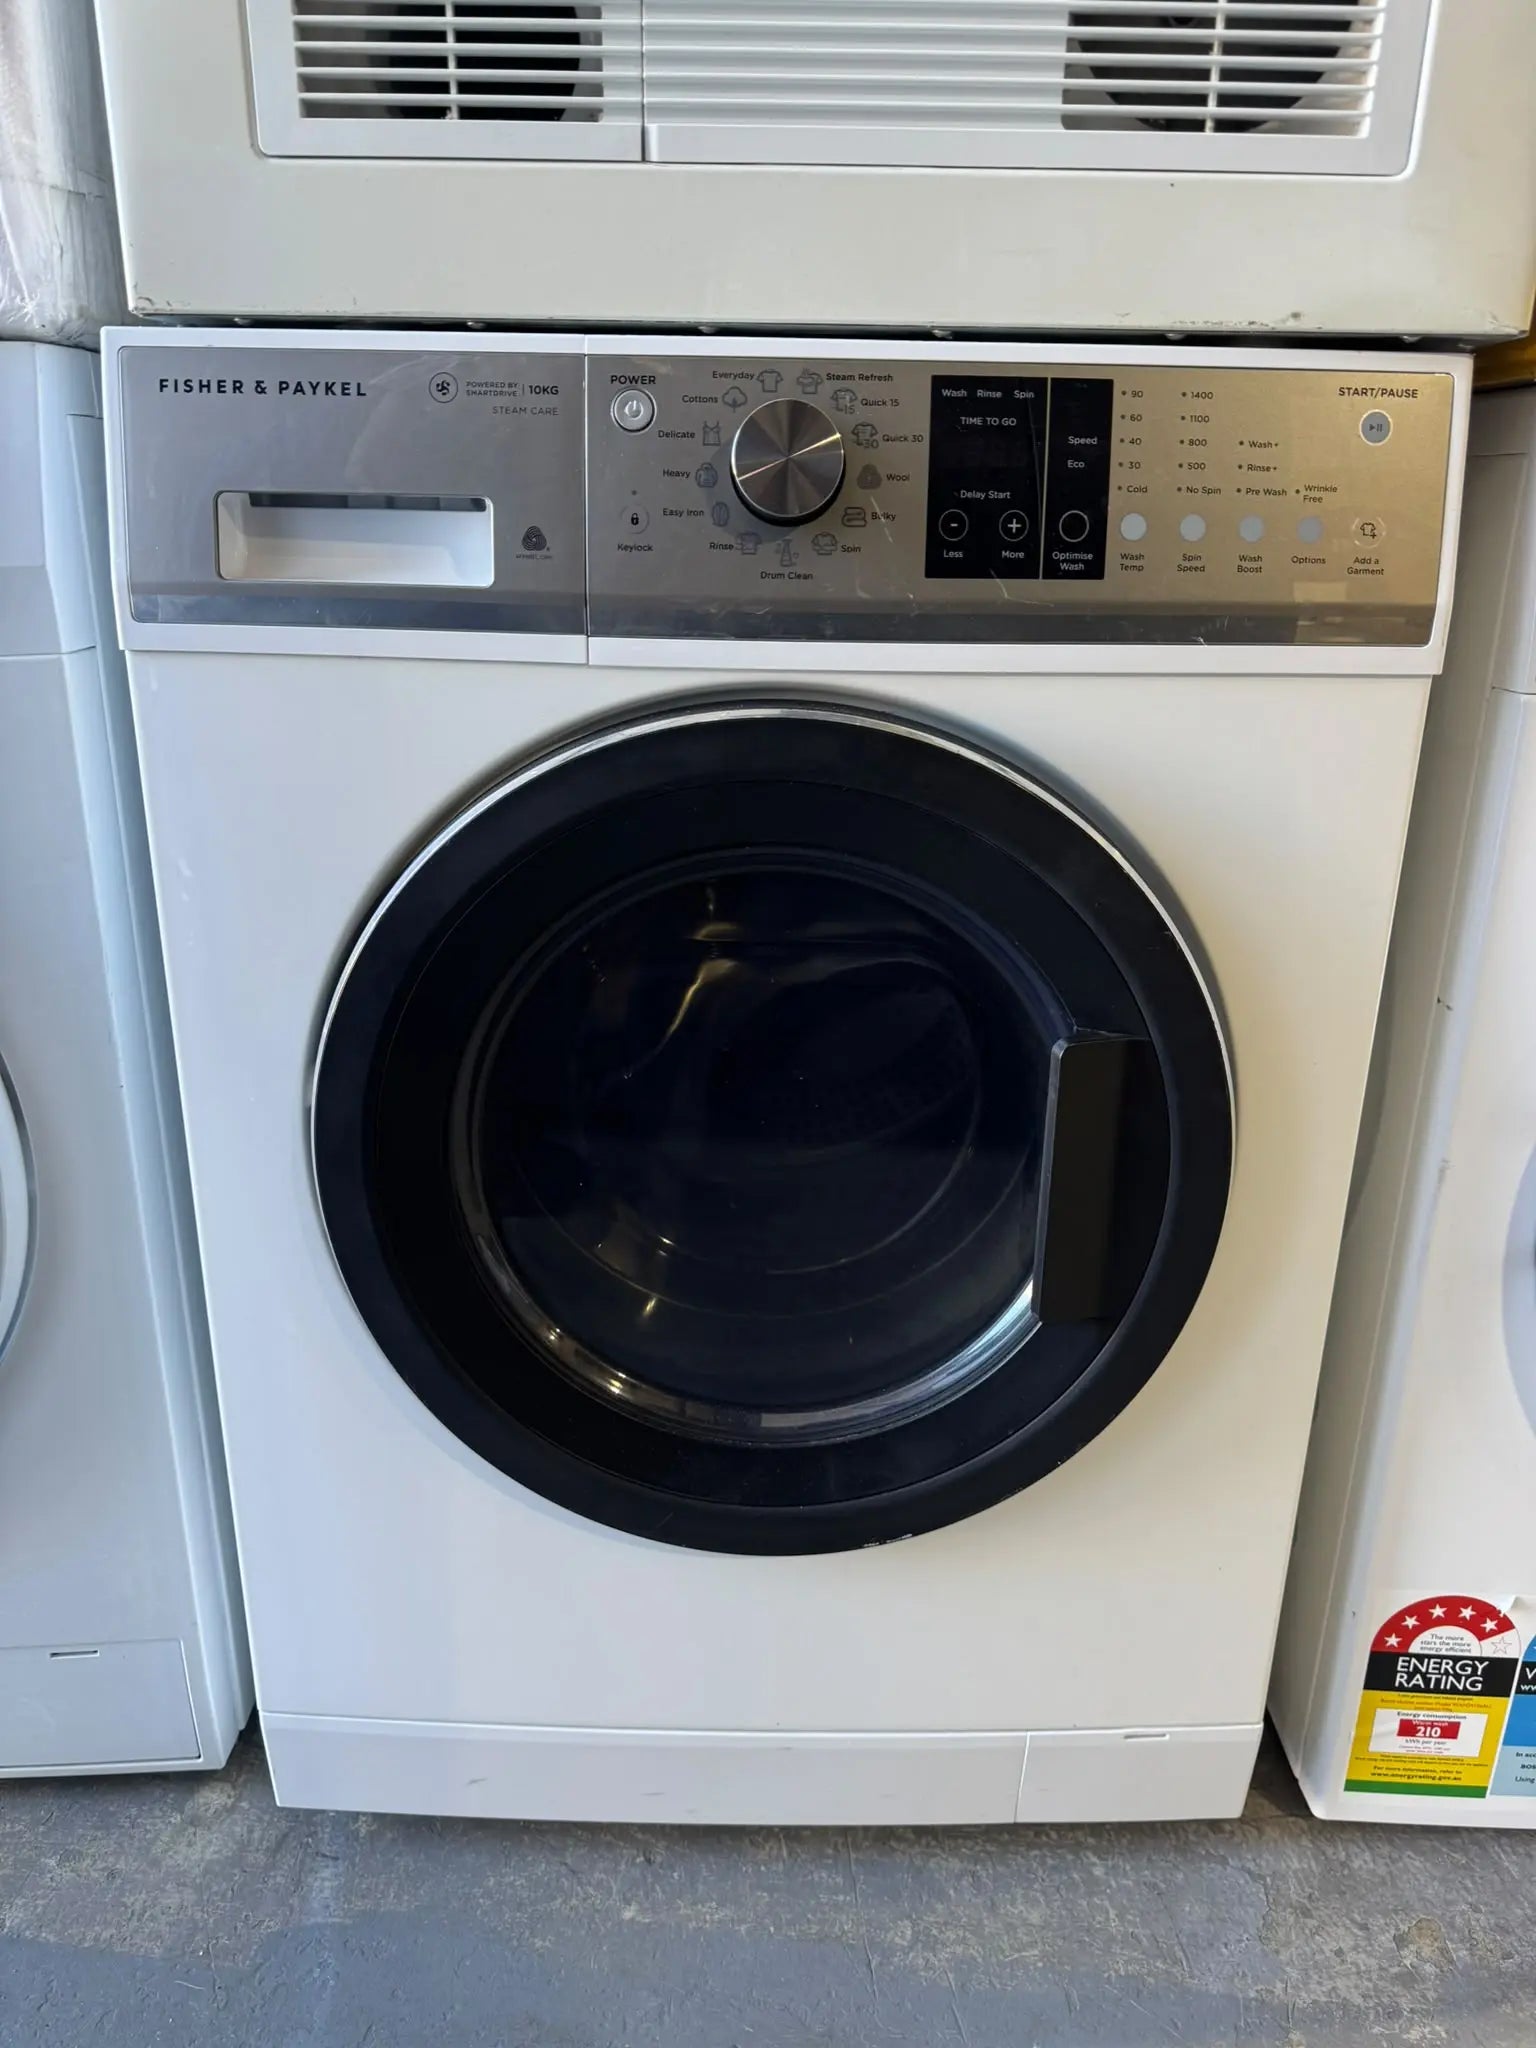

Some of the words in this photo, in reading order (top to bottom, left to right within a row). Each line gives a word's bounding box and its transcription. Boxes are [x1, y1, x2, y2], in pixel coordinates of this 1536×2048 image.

[610, 375, 656, 385] POWER
[712, 371, 755, 380] Everyday
[826, 373, 855, 382] Steam
[858, 373, 893, 382] Refresh
[159, 378, 244, 394] FISHER
[254, 380, 267, 394] &
[278, 381, 367, 397] PAYKEL
[529, 384, 559, 395] 10KG
[466, 389, 518, 397] SMARTDRIVE
[941, 388, 967, 397] Wash
[977, 389, 1002, 399] Rinse
[1013, 390, 1035, 399] Spin
[1131, 390, 1144, 398] 90
[1191, 391, 1214, 400] 1400
[1338, 386, 1418, 399] START/PAUSE
[682, 395, 718, 403] Cottons
[861, 399, 888, 407] Quick
[890, 399, 899, 407] 15
[492, 406, 527, 415] STEAM
[530, 407, 559, 416] CARE
[960, 416, 983, 425] TIME
[986, 417, 999, 426] TO
[1001, 417, 1017, 426] GO
[1129, 414, 1142, 422] 60
[1189, 414, 1210, 423] 1100
[658, 430, 696, 439] Delicate
[882, 434, 908, 443] Quick
[911, 434, 924, 443] 30
[1067, 436, 1098, 445] Speed
[1128, 437, 1142, 446] 40
[1187, 438, 1207, 447] 800
[1067, 460, 1085, 469] Eco
[1128, 461, 1141, 470] 30
[1187, 462, 1206, 471] 500
[662, 469, 691, 478] Heavy
[886, 474, 910, 482] Wool
[1126, 484, 1148, 493] Cold
[1186, 486, 1200, 494] No
[1201, 486, 1222, 496] Spin
[1245, 487, 1262, 496] Pre
[1263, 487, 1287, 496] Wash
[1304, 484, 1338, 493] Wrinkle
[960, 490, 986, 500] Delay
[988, 490, 1011, 499] Start
[1303, 494, 1323, 503] Free
[662, 508, 684, 517] Easy
[871, 512, 896, 521] Bulky
[617, 543, 653, 553] Keylock
[709, 542, 734, 550] Rinse
[841, 545, 862, 553] Spin
[943, 550, 963, 558] Less
[1001, 550, 1025, 559] More
[1052, 551, 1093, 561] Optimise
[1120, 553, 1145, 561] Wash
[1182, 553, 1202, 562] Spin
[1238, 554, 1263, 562] Wash
[1291, 556, 1326, 565] Options
[1353, 556, 1372, 565] Add
[1059, 562, 1085, 571] Wash
[1119, 563, 1144, 572] Temp
[1177, 564, 1206, 573] Speed
[1237, 565, 1263, 573] Boost
[1346, 566, 1384, 576] Garment
[760, 571, 785, 580] Drum
[787, 571, 813, 580] Clean
[1396, 1656, 1490, 1675] ENERGY
[1394, 1672, 1484, 1692] RATING
[1422, 1712, 1467, 1720] consumption
[1415, 1726, 1441, 1738] 210
